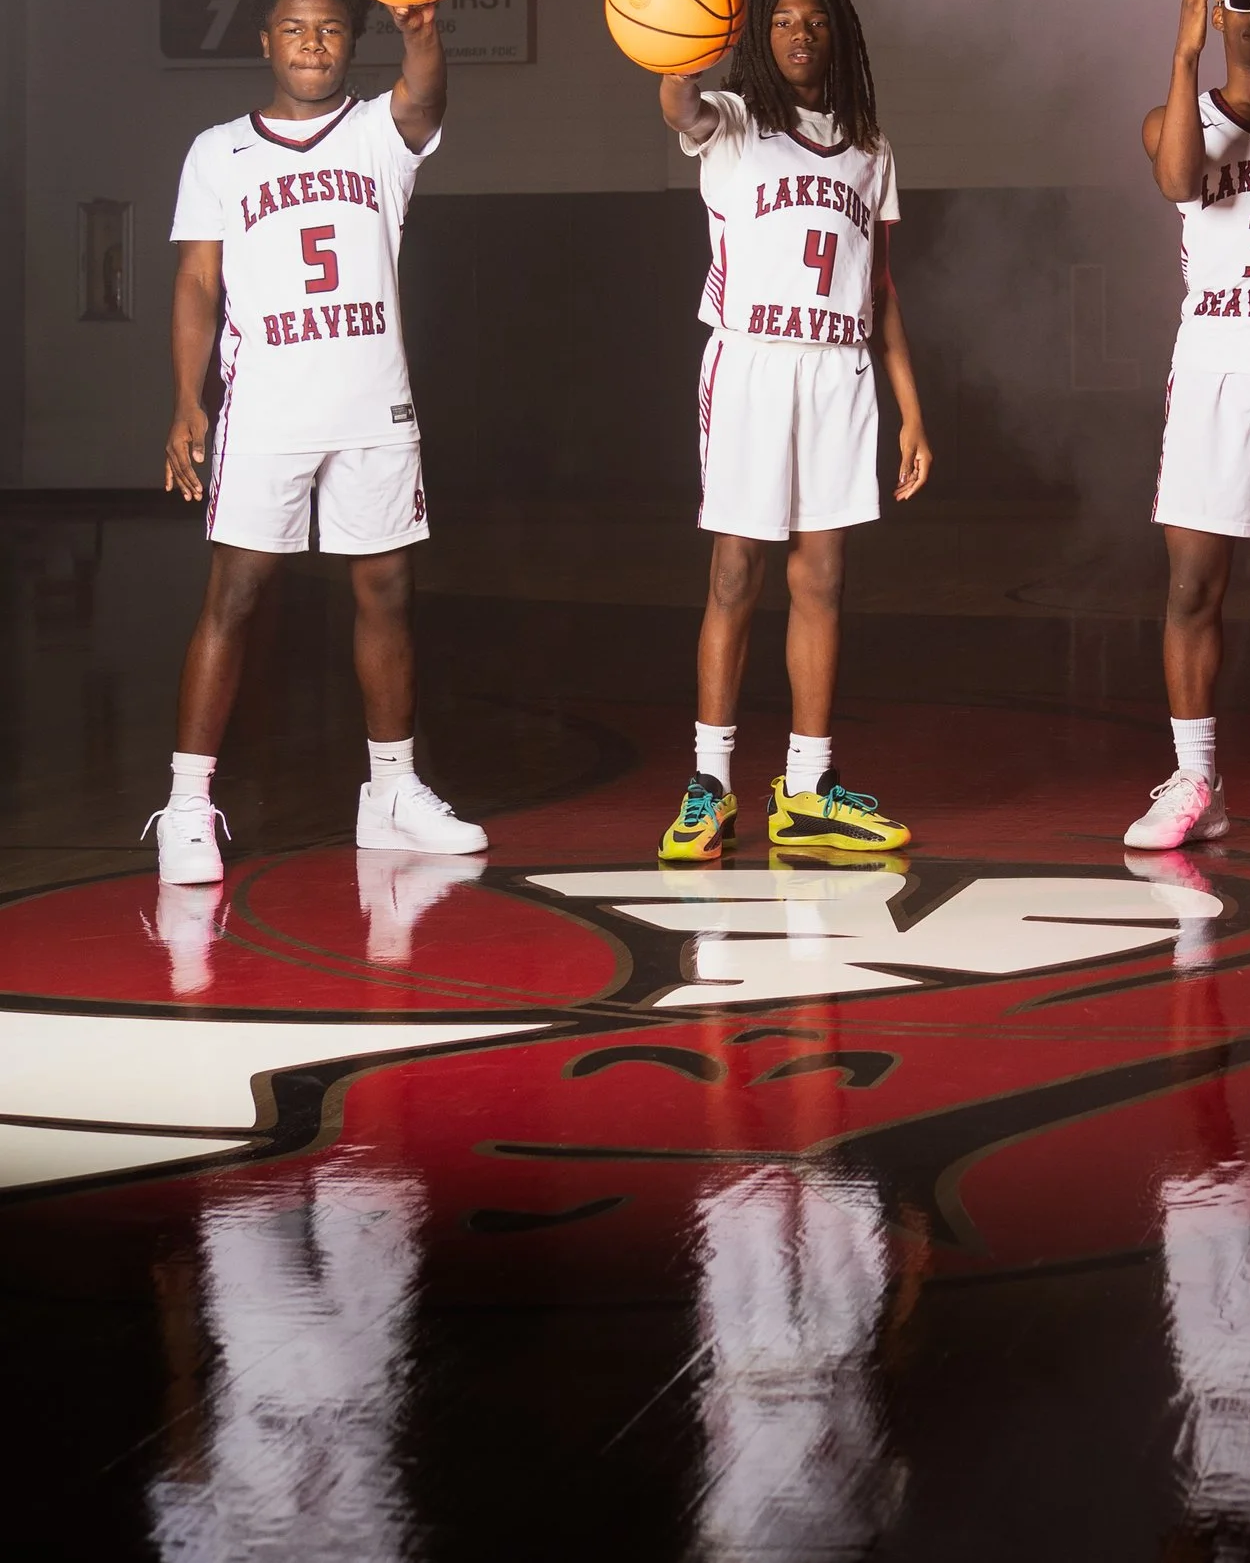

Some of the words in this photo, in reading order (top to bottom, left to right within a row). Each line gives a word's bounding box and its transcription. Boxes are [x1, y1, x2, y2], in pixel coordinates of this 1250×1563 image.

[241, 169, 379, 232] LAKESIDE
[755, 175, 871, 241] LAKESIDE
[300, 224, 339, 294] 5
[803, 229, 838, 297] 4
[263, 301, 387, 346] BEAVERS
[748, 304, 867, 345] BEAVERS
